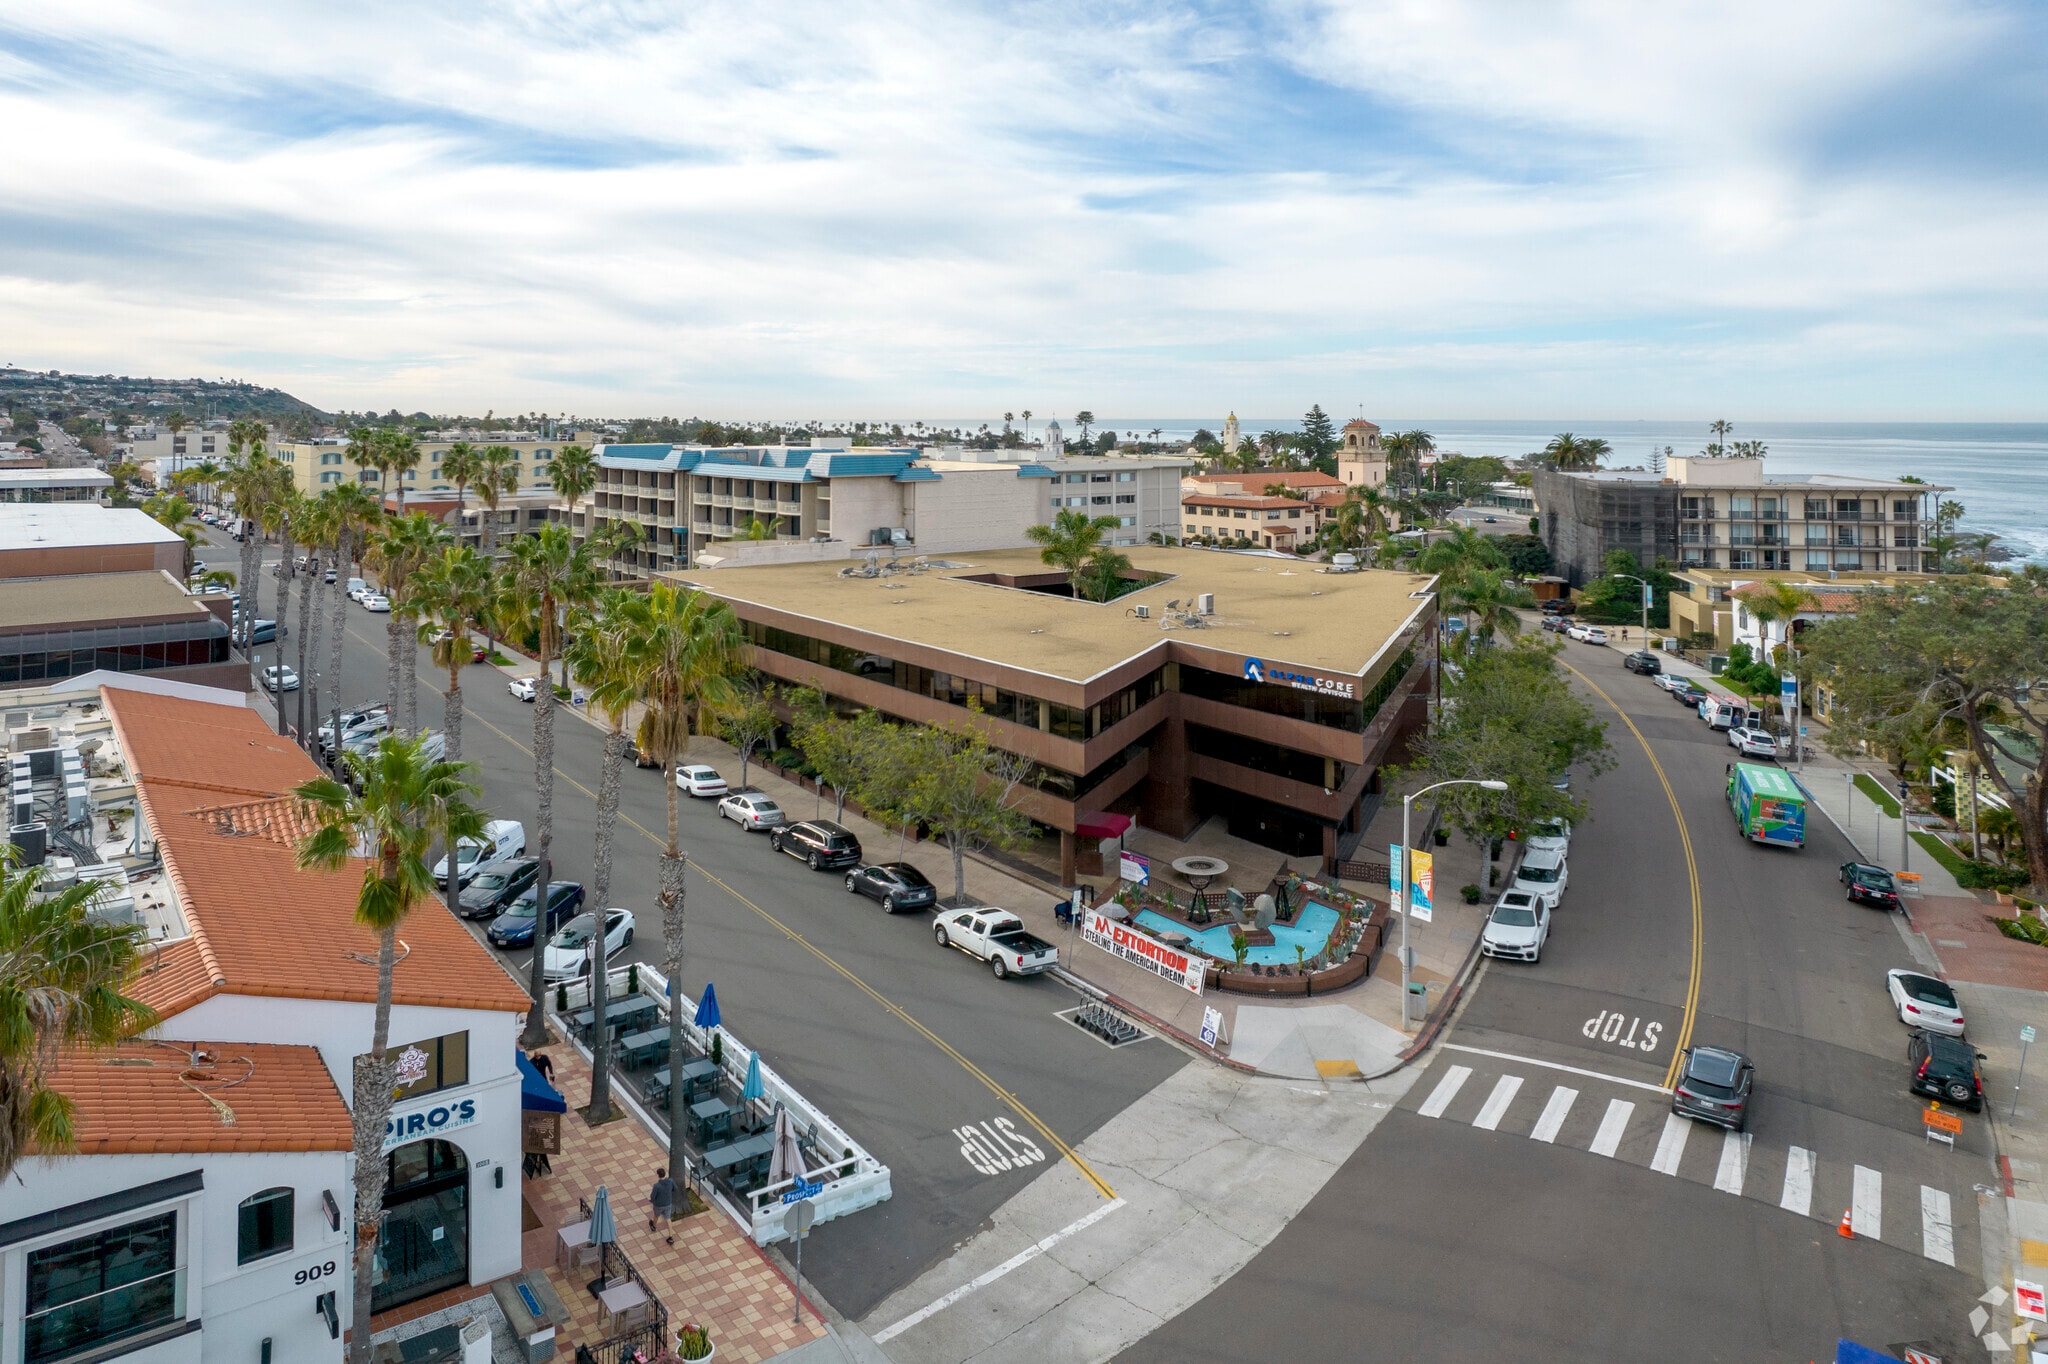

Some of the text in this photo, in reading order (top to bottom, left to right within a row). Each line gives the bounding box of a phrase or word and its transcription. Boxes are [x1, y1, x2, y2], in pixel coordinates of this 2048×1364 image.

[1291, 682, 1317, 692] WEALTH
[498, 835, 510, 845] OTIS
[1085, 929, 1111, 951] STEALING
[1112, 942, 1124, 957] THE
[1125, 949, 1158, 973] AMERICAN
[1160, 965, 1185, 987] DREAM
[1113, 926, 1188, 974] EXTORTION
[1582, 1010, 1663, 1052] STOP
[438, 1117, 475, 1131] CUISINE
[952, 1117, 1045, 1175] STOP
[294, 1261, 336, 1285] 909
